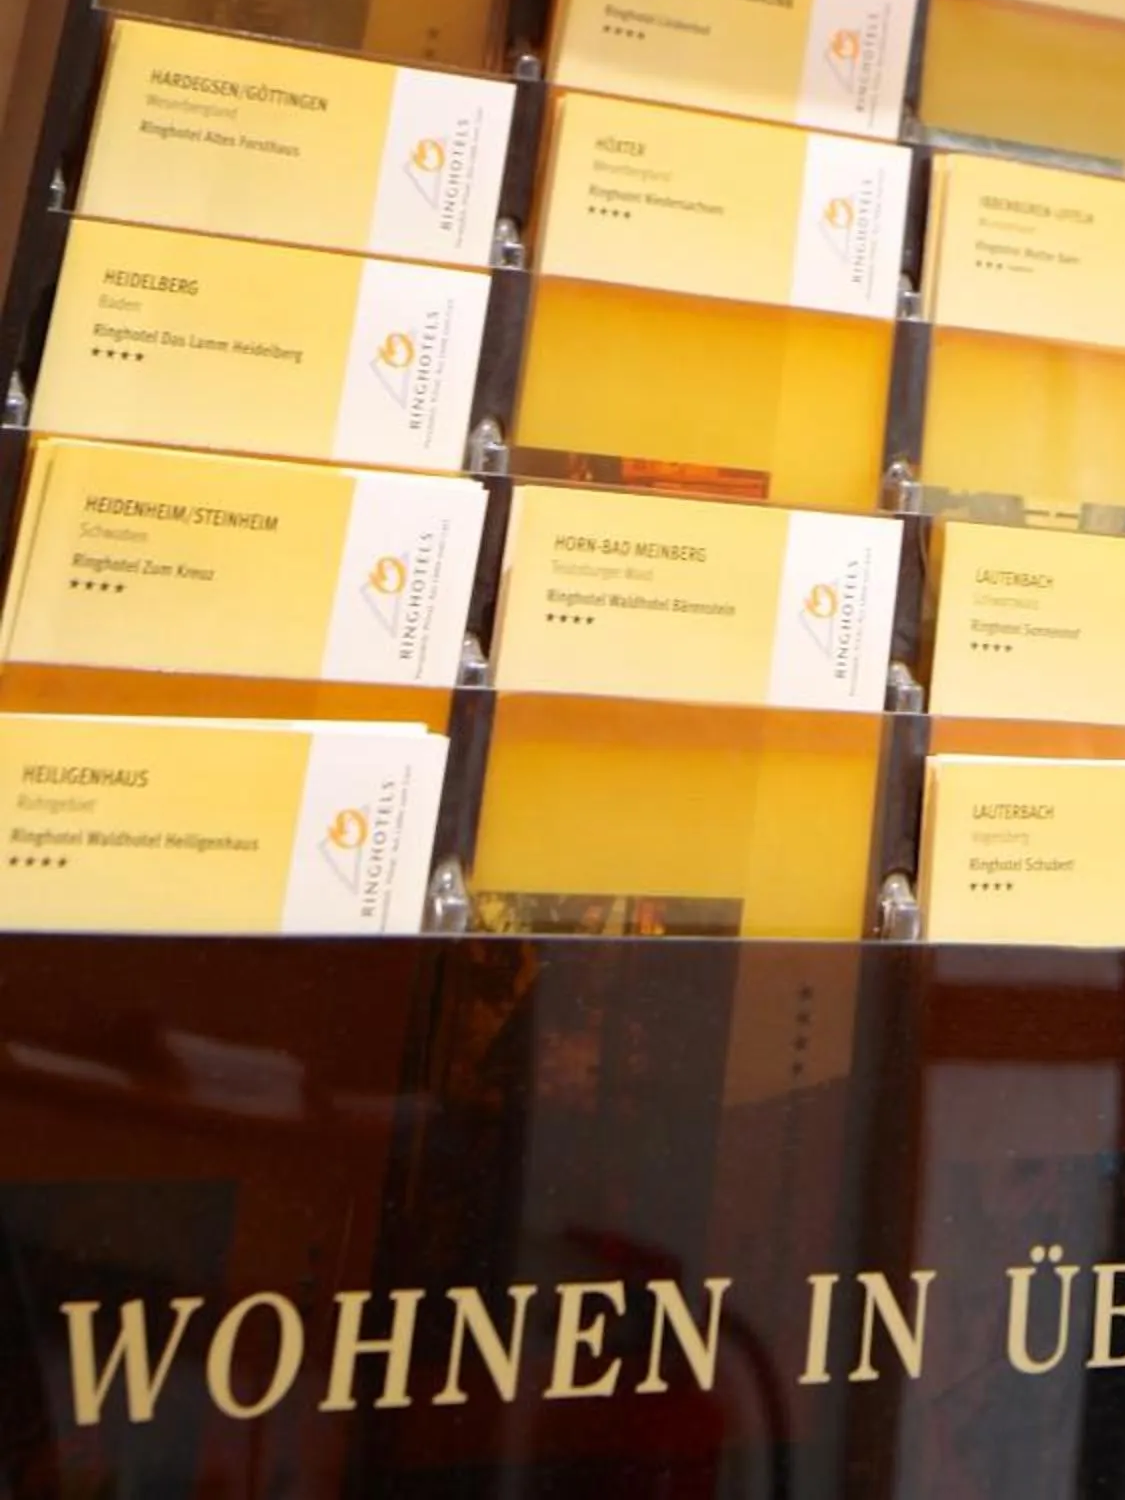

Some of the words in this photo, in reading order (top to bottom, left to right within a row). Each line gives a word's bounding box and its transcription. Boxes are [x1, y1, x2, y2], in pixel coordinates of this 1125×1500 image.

[139, 119, 201, 144] Ringhotel
[439, 117, 469, 232] RINGHOTELS
[103, 268, 199, 296] HEIDELBERG
[92, 322, 158, 345] Ringhotel
[160, 329, 186, 347] Das
[188, 333, 230, 352] Lamm
[232, 338, 304, 365] Heidelberg
[409, 309, 440, 431] RINGHOTELS
[84, 496, 279, 532] HEIDENHEIM/STEINHEIM
[554, 534, 632, 558] HORN-BAD
[634, 540, 707, 563] MEINBERG
[72, 551, 140, 576] Ringhotel
[141, 558, 174, 578] Zum
[176, 563, 216, 582] Kreuz
[398, 531, 434, 661] RINGHOTELS
[546, 588, 607, 610] Ringhotel
[833, 558, 860, 681] RINGHOTELS
[21, 765, 150, 789] HEILIGENHAUS
[972, 803, 1055, 822] LAUTERBACH
[9, 826, 84, 848] Ringhotel
[86, 830, 162, 850] Waldhotel
[165, 832, 260, 854] Heiligenhaus
[361, 779, 396, 919] RINGHOTELS
[969, 856, 1022, 875] Ringhotel
[58, 1274, 732, 1428] WOHNEN
[797, 1268, 935, 1388] IN
